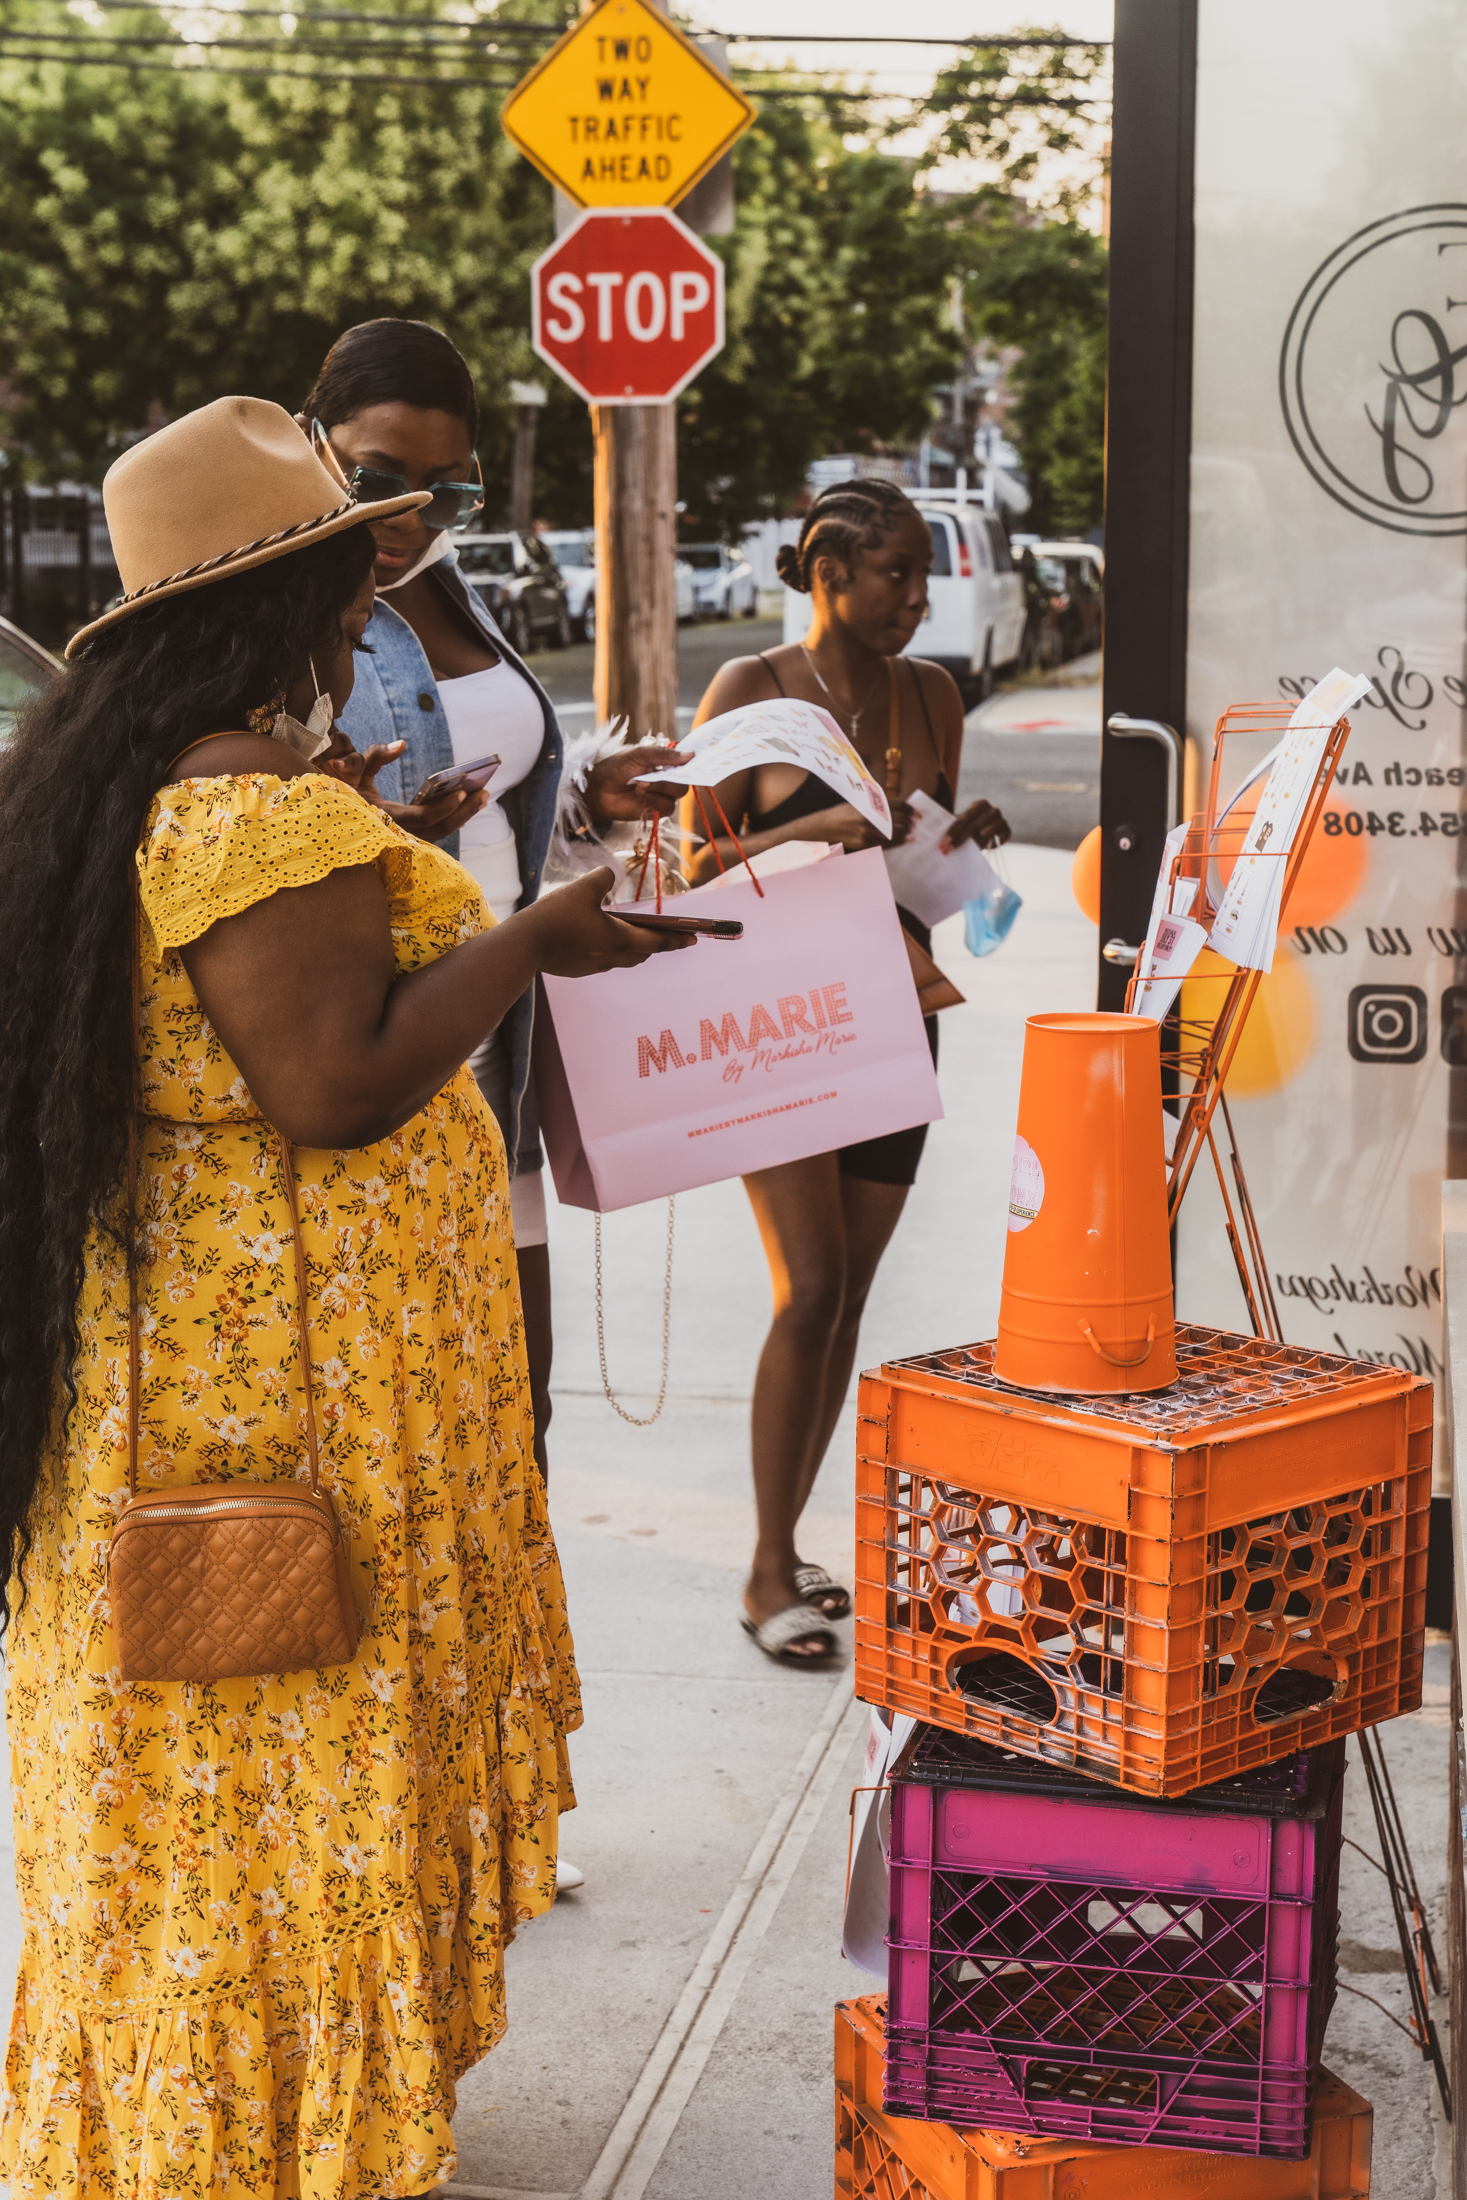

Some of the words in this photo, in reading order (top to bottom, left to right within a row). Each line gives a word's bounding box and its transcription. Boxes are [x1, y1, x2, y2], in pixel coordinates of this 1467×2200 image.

[597, 34, 653, 64] TWO
[596, 75, 652, 103] WAY
[568, 114, 683, 145] TRAFFIC
[580, 154, 671, 184] AHEAD
[545, 271, 710, 343] STOP
[637, 981, 854, 1078] M.MARIE
[722, 1058, 744, 1083] By
